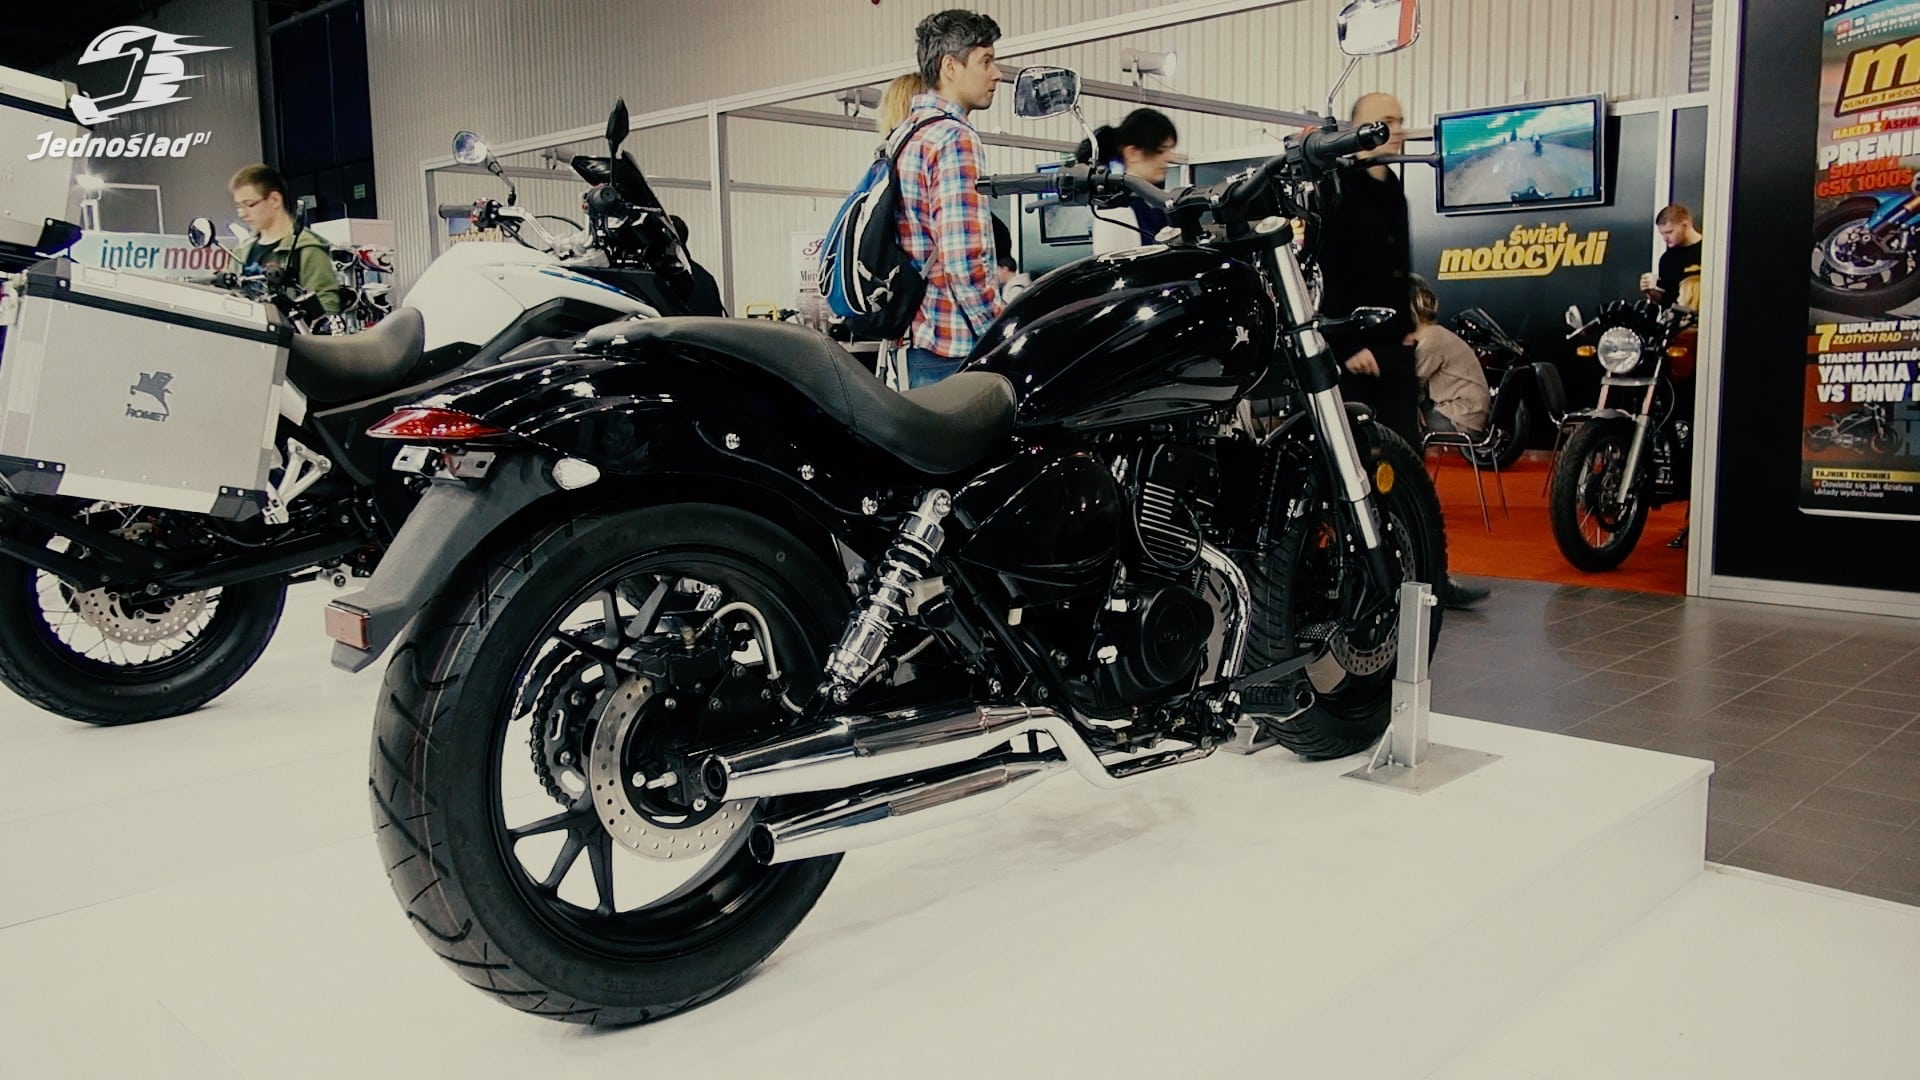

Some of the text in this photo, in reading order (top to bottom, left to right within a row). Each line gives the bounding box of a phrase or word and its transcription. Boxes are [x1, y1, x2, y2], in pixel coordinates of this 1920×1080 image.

[1509, 222, 1568, 245] świat
[101, 239, 159, 268] inter
[1438, 231, 1609, 274] motocykli
[1816, 324, 1838, 352] 7
[1866, 348, 1920, 362] KLASYKÓ
[1818, 363, 1911, 383] YAMAHA
[1817, 384, 1846, 403] VS
[1851, 383, 1906, 403] BMW
